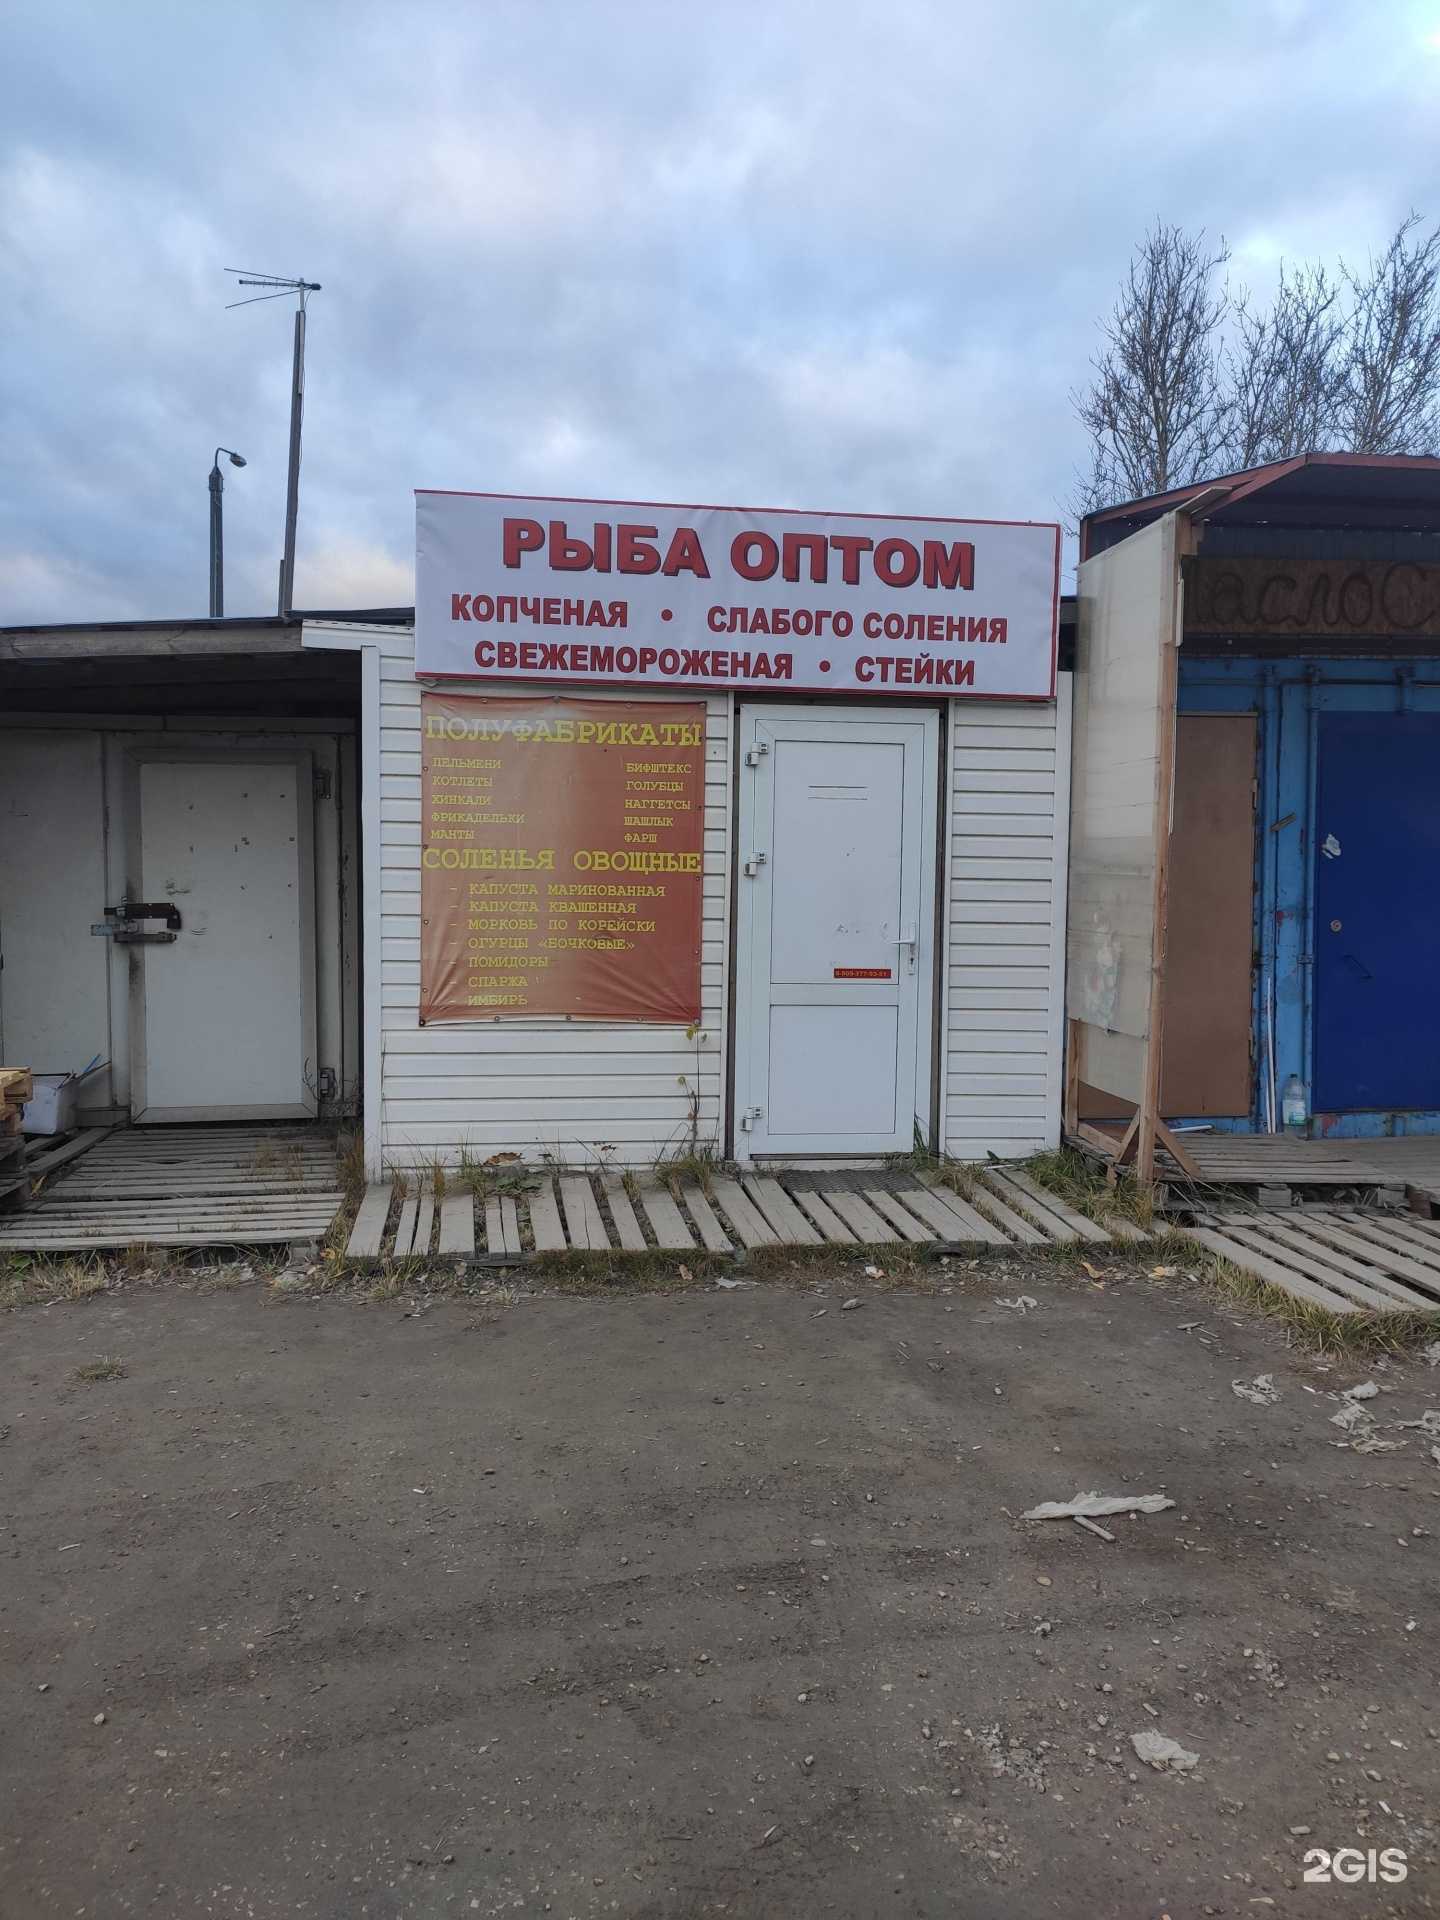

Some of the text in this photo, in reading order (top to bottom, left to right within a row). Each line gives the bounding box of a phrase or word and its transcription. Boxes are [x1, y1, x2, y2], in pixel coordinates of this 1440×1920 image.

[502, 518, 975, 591] РЫБА ОПТОМ
[451, 593, 628, 628] КОПЧЕНАЯ
[707, 605, 1008, 644] СЛАБОГО СОЛЕНИЯ
[474, 640, 793, 681] СВЕЖЕМОРОЖЕНАЯ
[855, 652, 975, 686] СТЕЙКИ
[425, 715, 702, 747] ПОЛУФАБРИКАТЫ
[431, 757, 502, 769] ПЕЛЬМЕНИ
[625, 763, 692, 774] БИФШТЕКС
[431, 775, 494, 787] КОТЛЕТЫ
[626, 781, 684, 793] ГОЛУБЦЫ
[624, 799, 691, 810] НАГГЕТСЫ
[431, 812, 525, 824] ФРИКАДЕЛЬКИ
[624, 816, 674, 827] ШАШЛЫК
[431, 829, 475, 840] МАНТЫ
[624, 832, 657, 843] ФАРШ
[422, 848, 702, 875] СОЛЕНЬЯ ОВОЩНЫЕ
[468, 883, 666, 897] КАПУСТА МАРИНОВАННАЯ
[468, 901, 637, 914] КАПУСТА КВАШЕННАЯ
[468, 917, 657, 932] МОРКОВЬ ПО КОРЕЙСКИ
[468, 938, 529, 950] ОГУРЦЫ
[468, 956, 549, 969] ПОМИДОРЫ
[468, 976, 529, 988] СПАРЖА
[468, 995, 528, 1007] ИМБИРЬ
